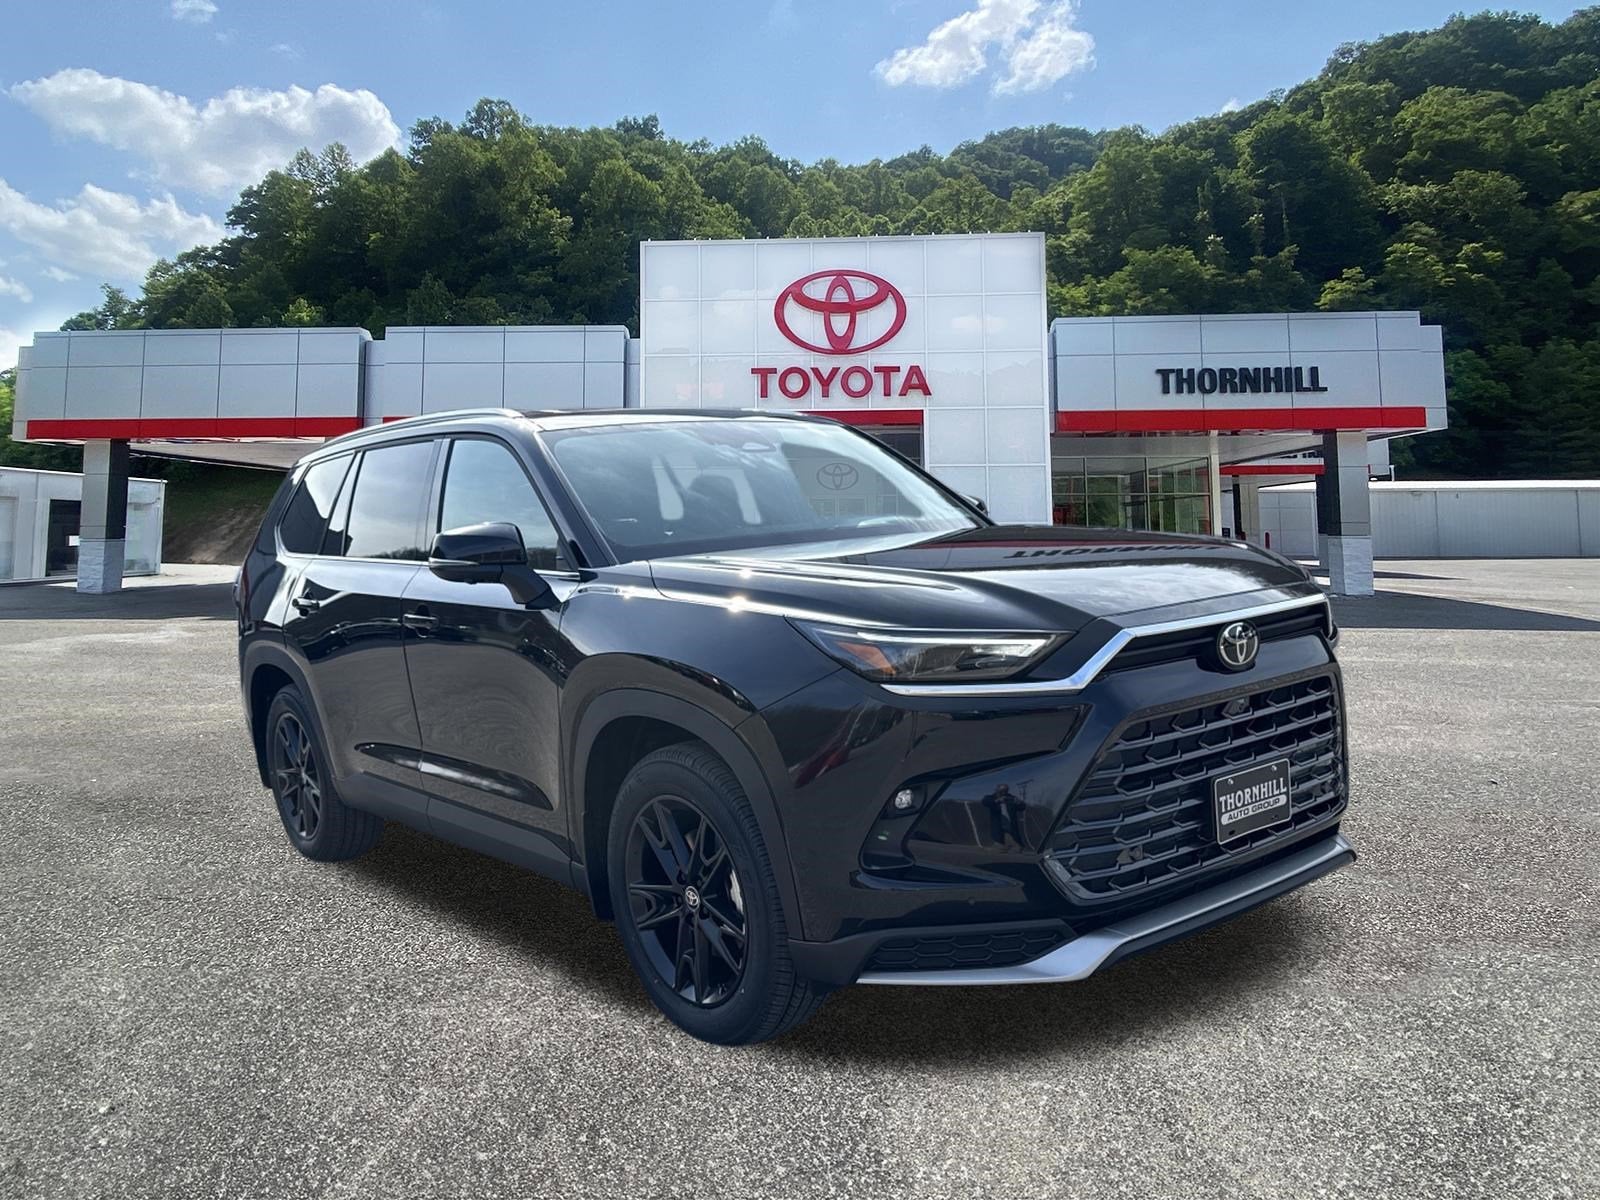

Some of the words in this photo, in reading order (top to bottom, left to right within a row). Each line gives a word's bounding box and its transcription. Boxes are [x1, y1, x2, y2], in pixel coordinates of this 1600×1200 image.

[751, 365, 932, 399] TOYOTA
[1155, 366, 1328, 394] THORNHILL
[1219, 777, 1287, 813] THORNHILL
[1227, 807, 1250, 822] AUTO
[1251, 797, 1280, 814] GROUP
